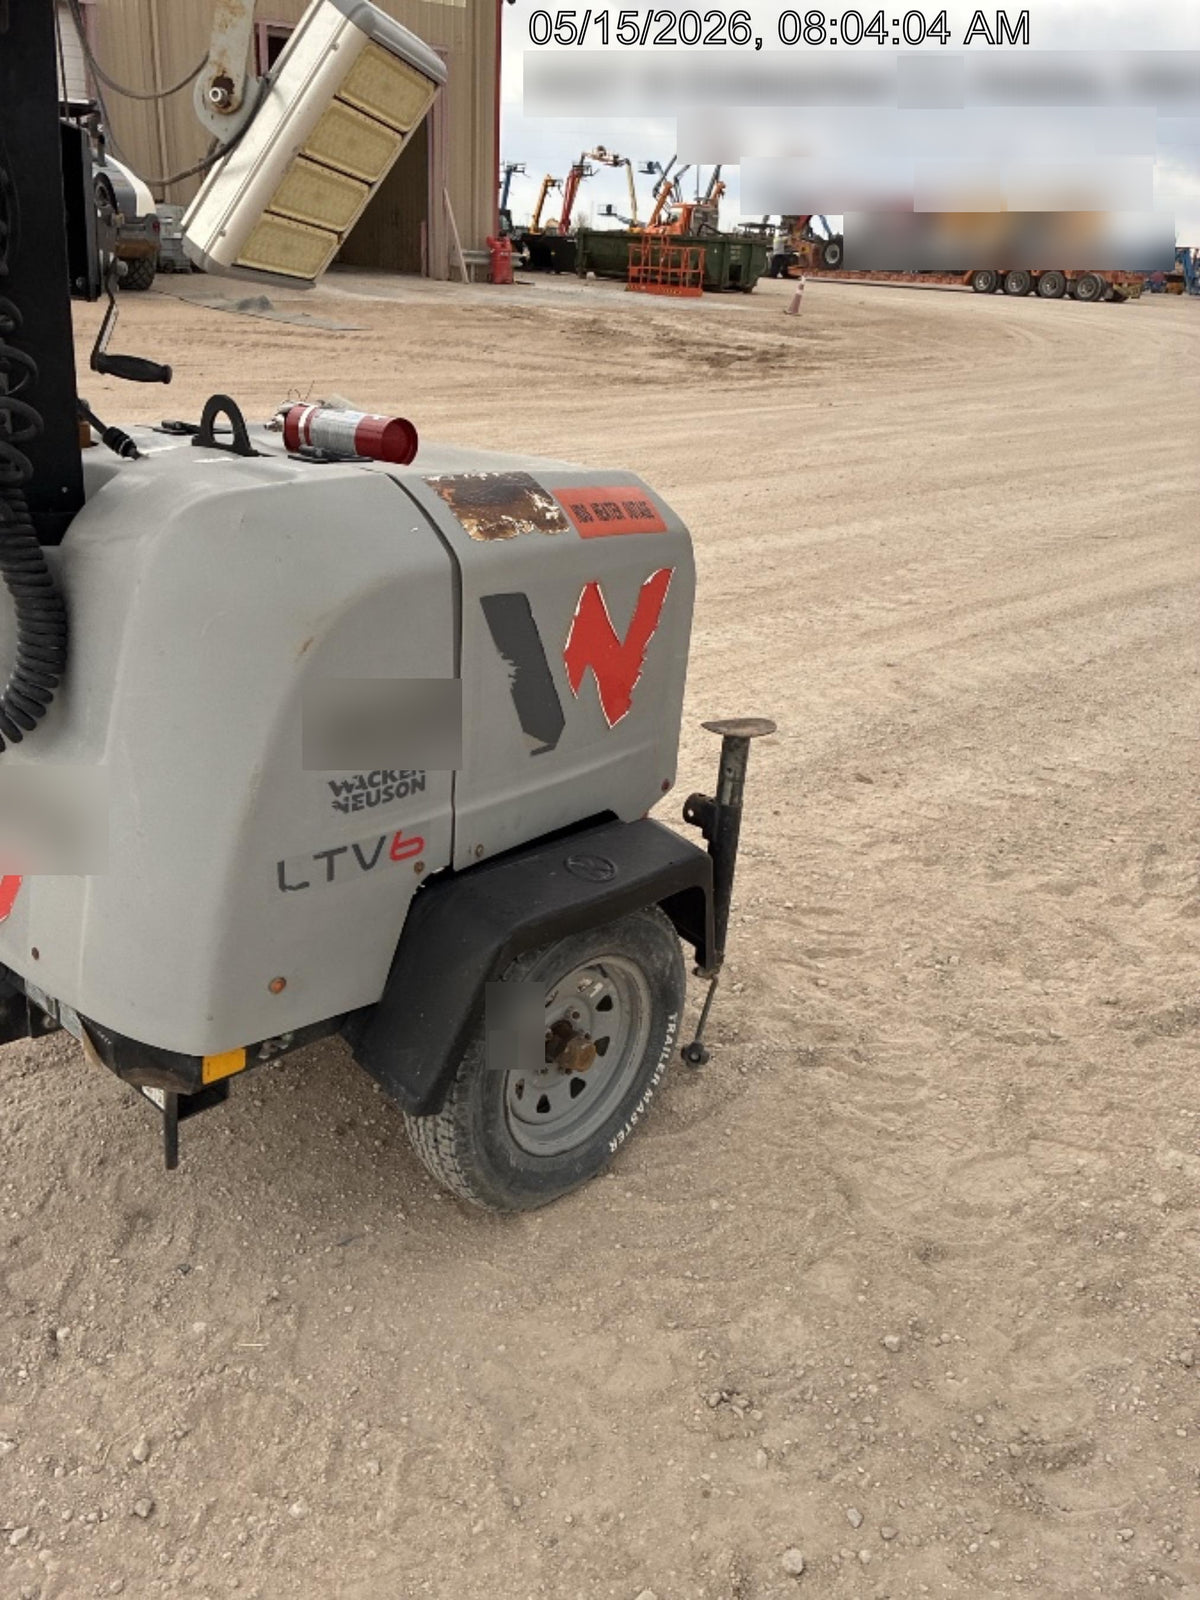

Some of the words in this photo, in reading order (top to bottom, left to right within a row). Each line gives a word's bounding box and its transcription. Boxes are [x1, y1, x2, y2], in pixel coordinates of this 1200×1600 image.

[277, 830, 425, 893] LTV6
[651, 1012, 678, 1085] TRAILER
[608, 1088, 653, 1153] MASTER
